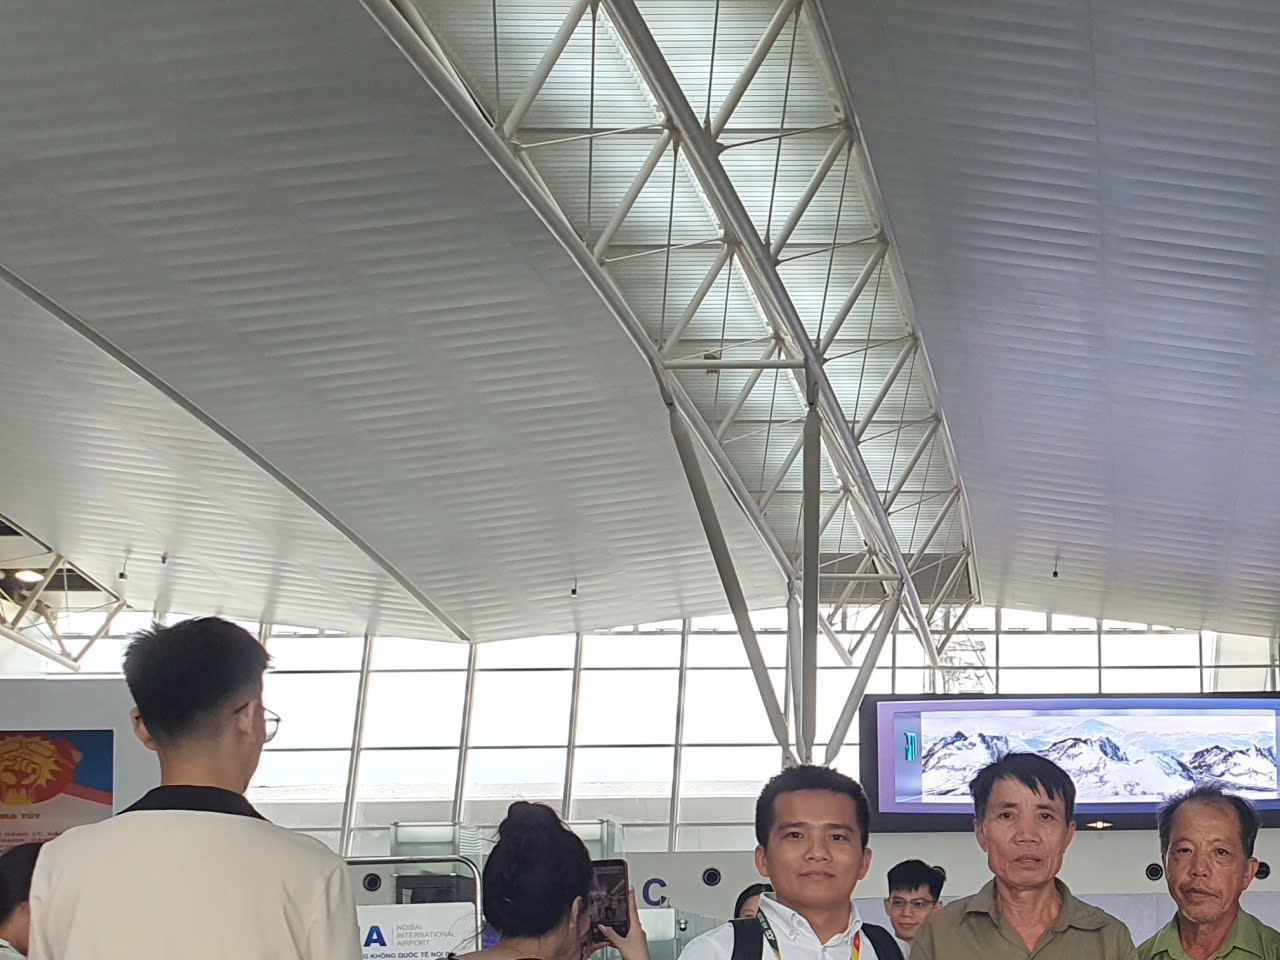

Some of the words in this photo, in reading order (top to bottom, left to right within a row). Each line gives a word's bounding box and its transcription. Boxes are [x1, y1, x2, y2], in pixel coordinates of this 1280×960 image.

[642, 878, 667, 907] C
[396, 930, 456, 939] INTERNATIONAL
[370, 951, 396, 959] KHÔNG
